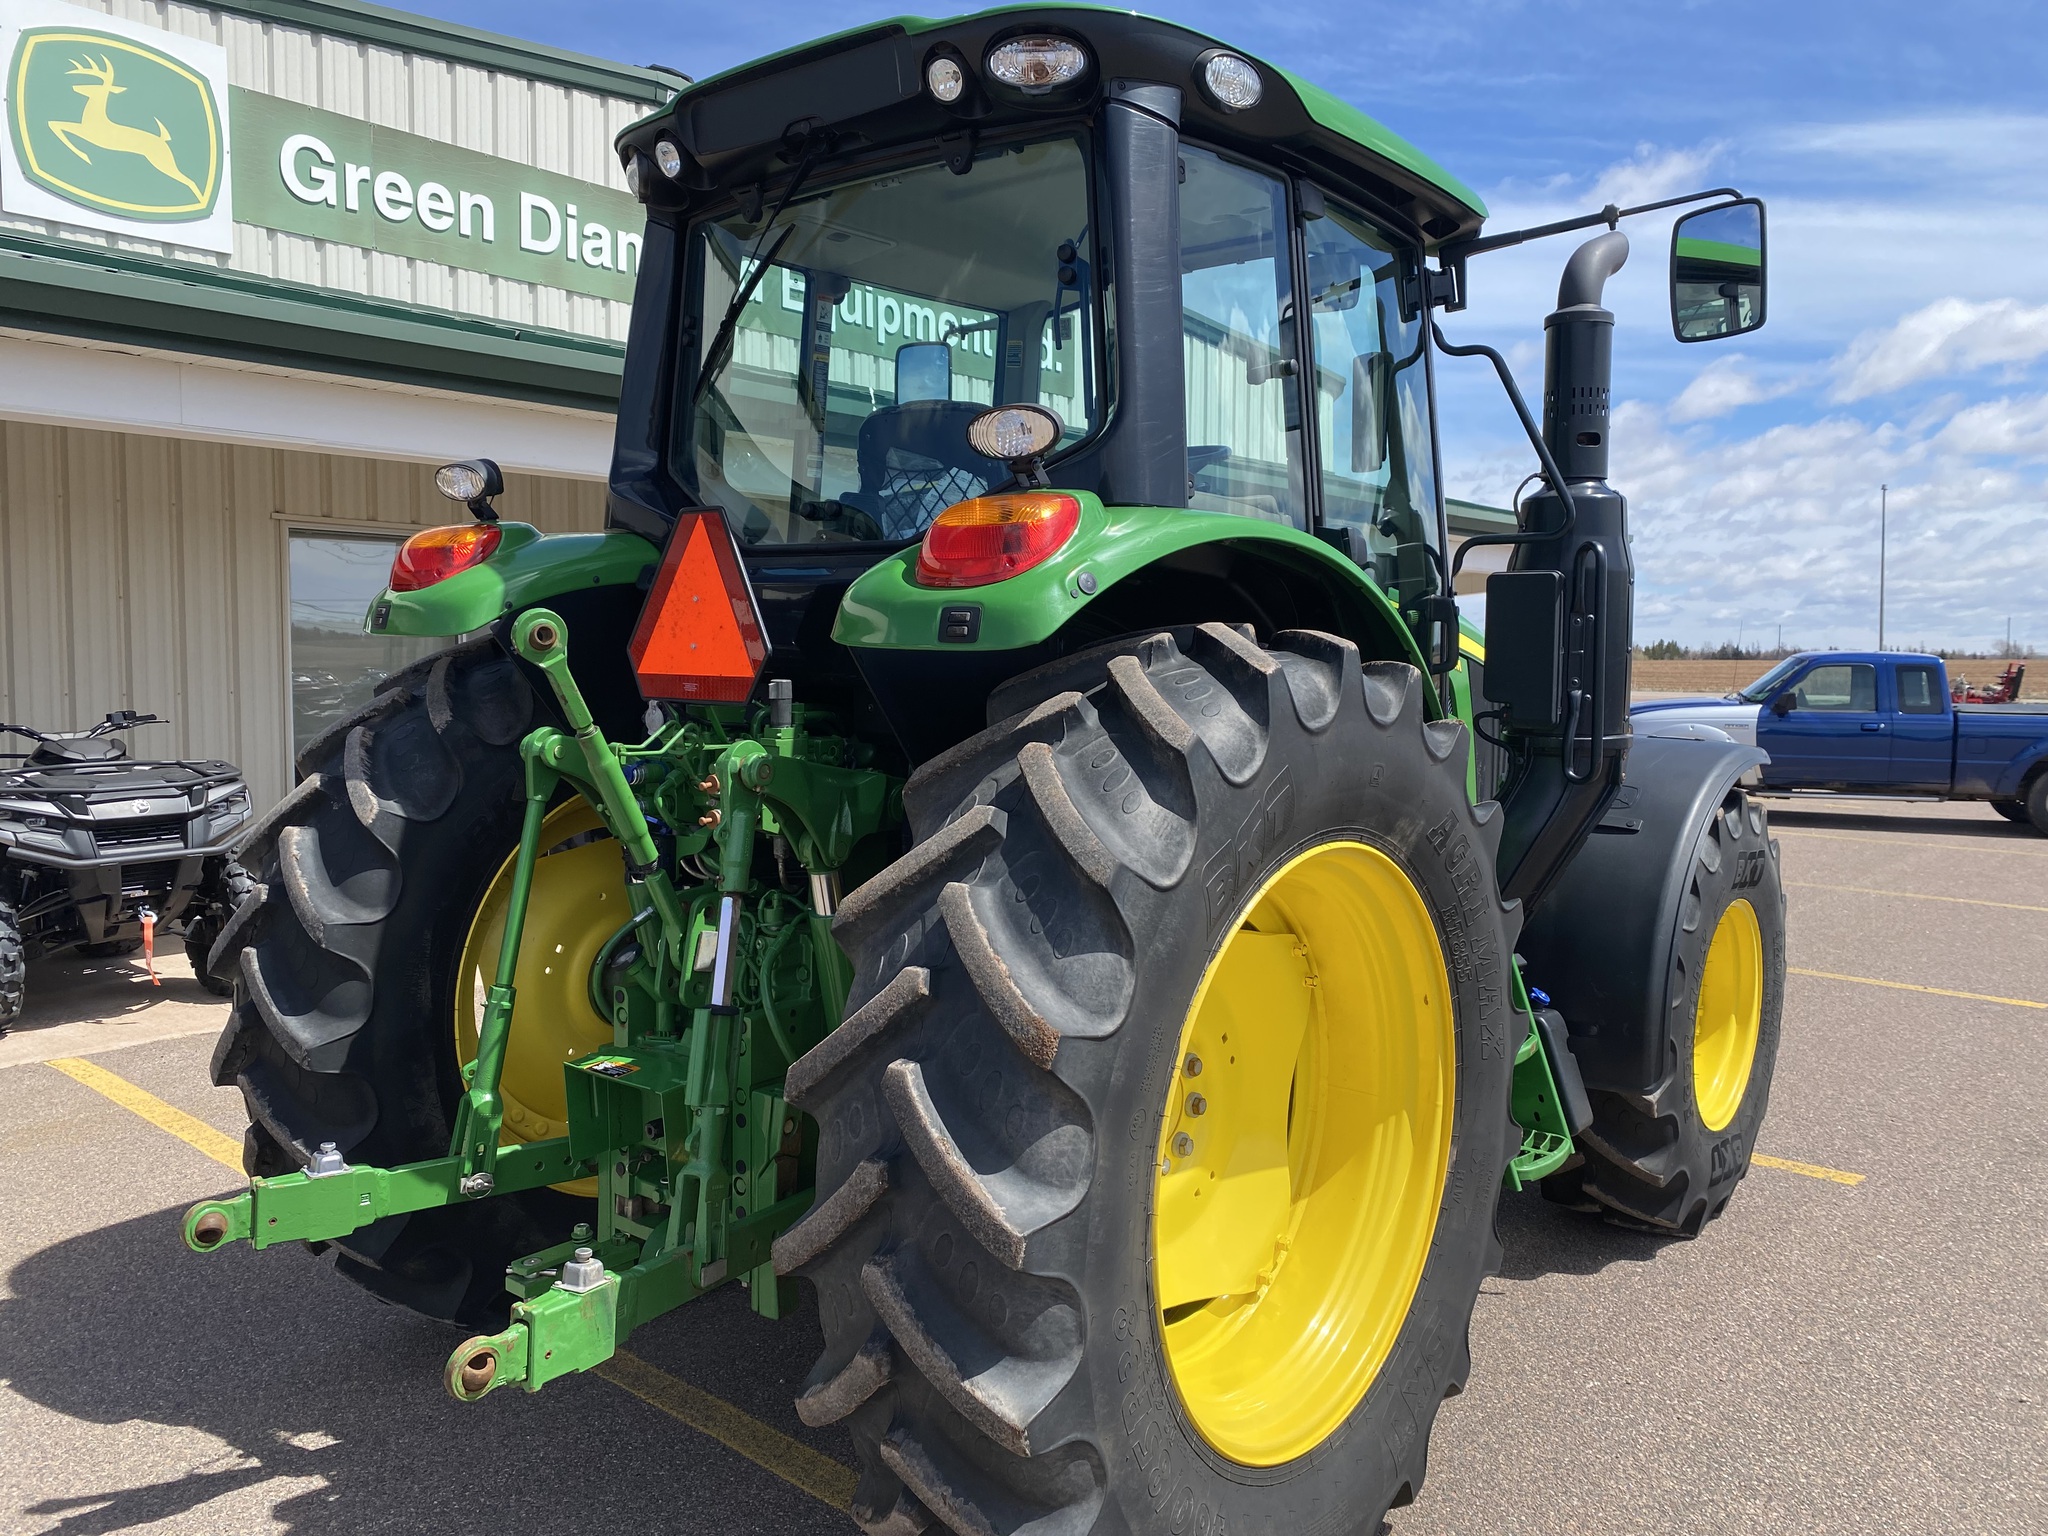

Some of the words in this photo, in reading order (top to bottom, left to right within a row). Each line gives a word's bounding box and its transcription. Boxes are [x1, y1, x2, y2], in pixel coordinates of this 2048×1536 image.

[280, 134, 495, 242] Green
[1201, 764, 1295, 941] BKT
[1731, 850, 1766, 890] BKT
[1427, 808, 1490, 927] AGRI
[1470, 928, 1504, 1060] MAX
[1708, 1133, 1744, 1188] BKT
